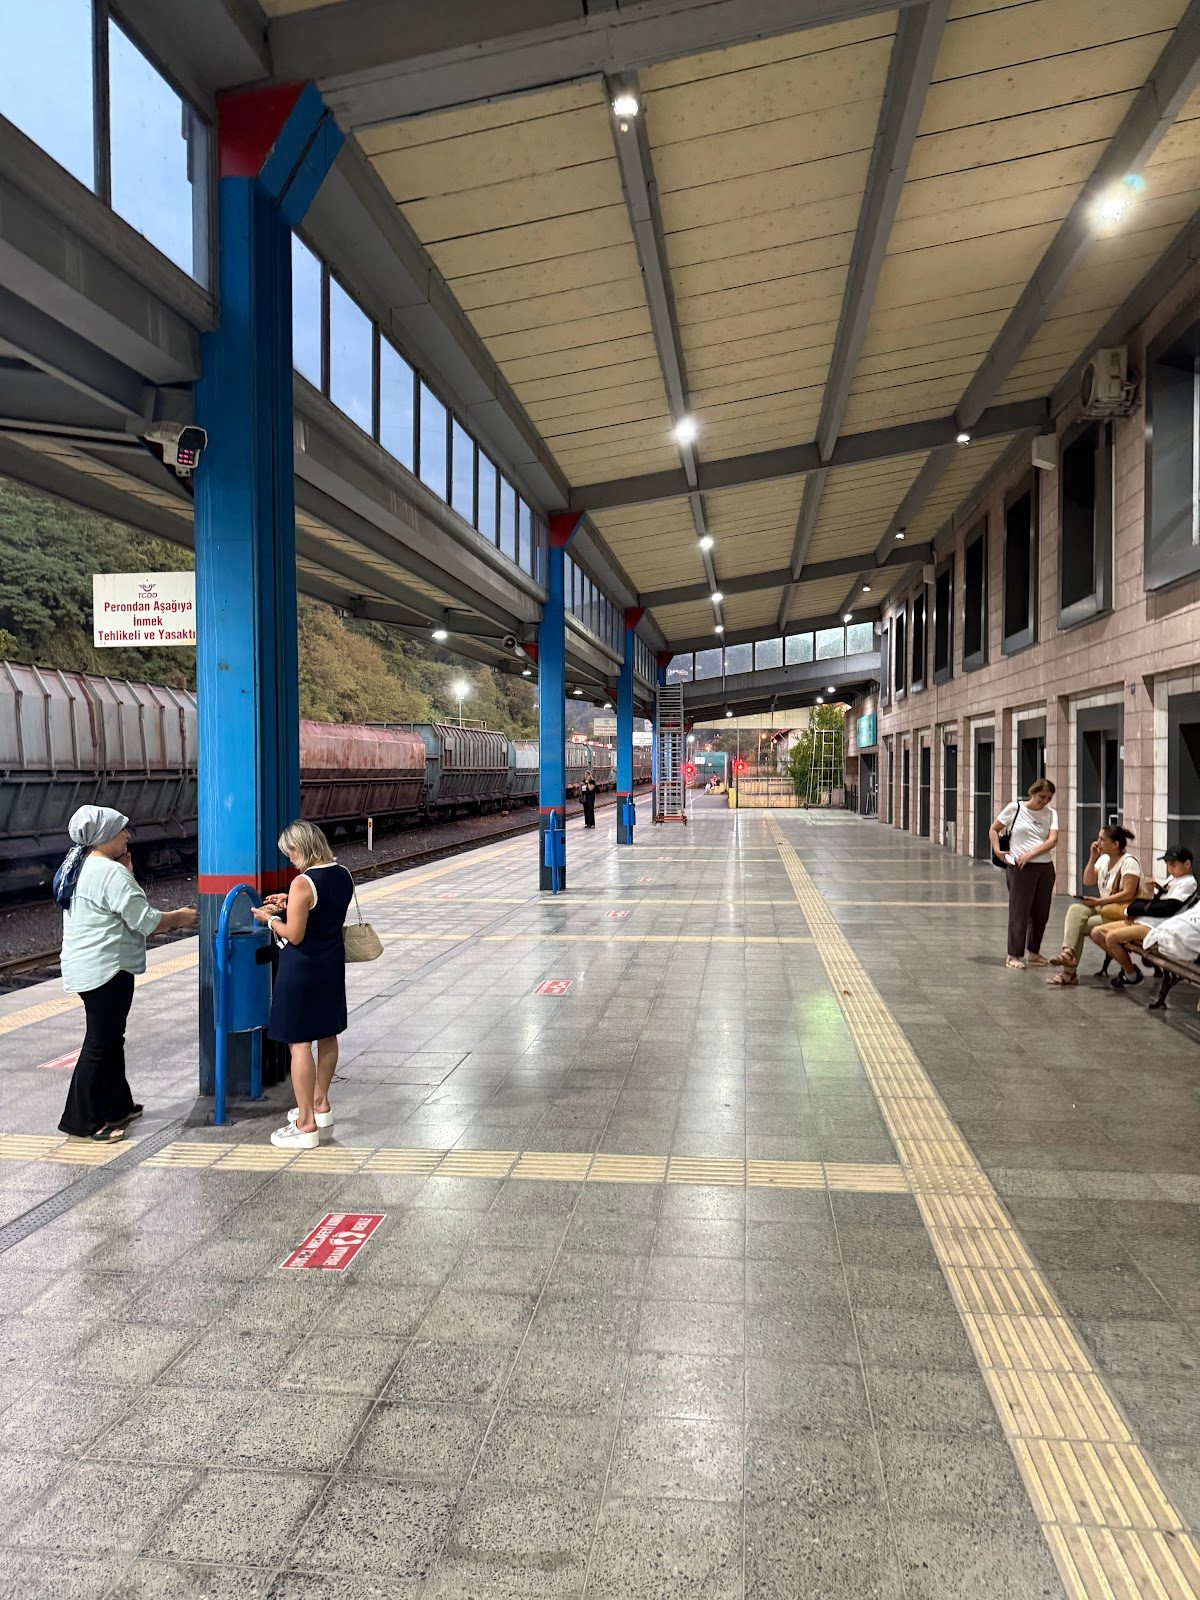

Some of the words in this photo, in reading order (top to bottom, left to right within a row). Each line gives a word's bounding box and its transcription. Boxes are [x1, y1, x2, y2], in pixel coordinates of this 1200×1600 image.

[104, 601, 150, 612] Perondan
[153, 600, 193, 613] Aşağıya
[133, 614, 163, 627] İnmek
[98, 630, 141, 641] Tehlikeli
[144, 631, 155, 640] ve
[159, 629, 196, 640] Yasaktı
